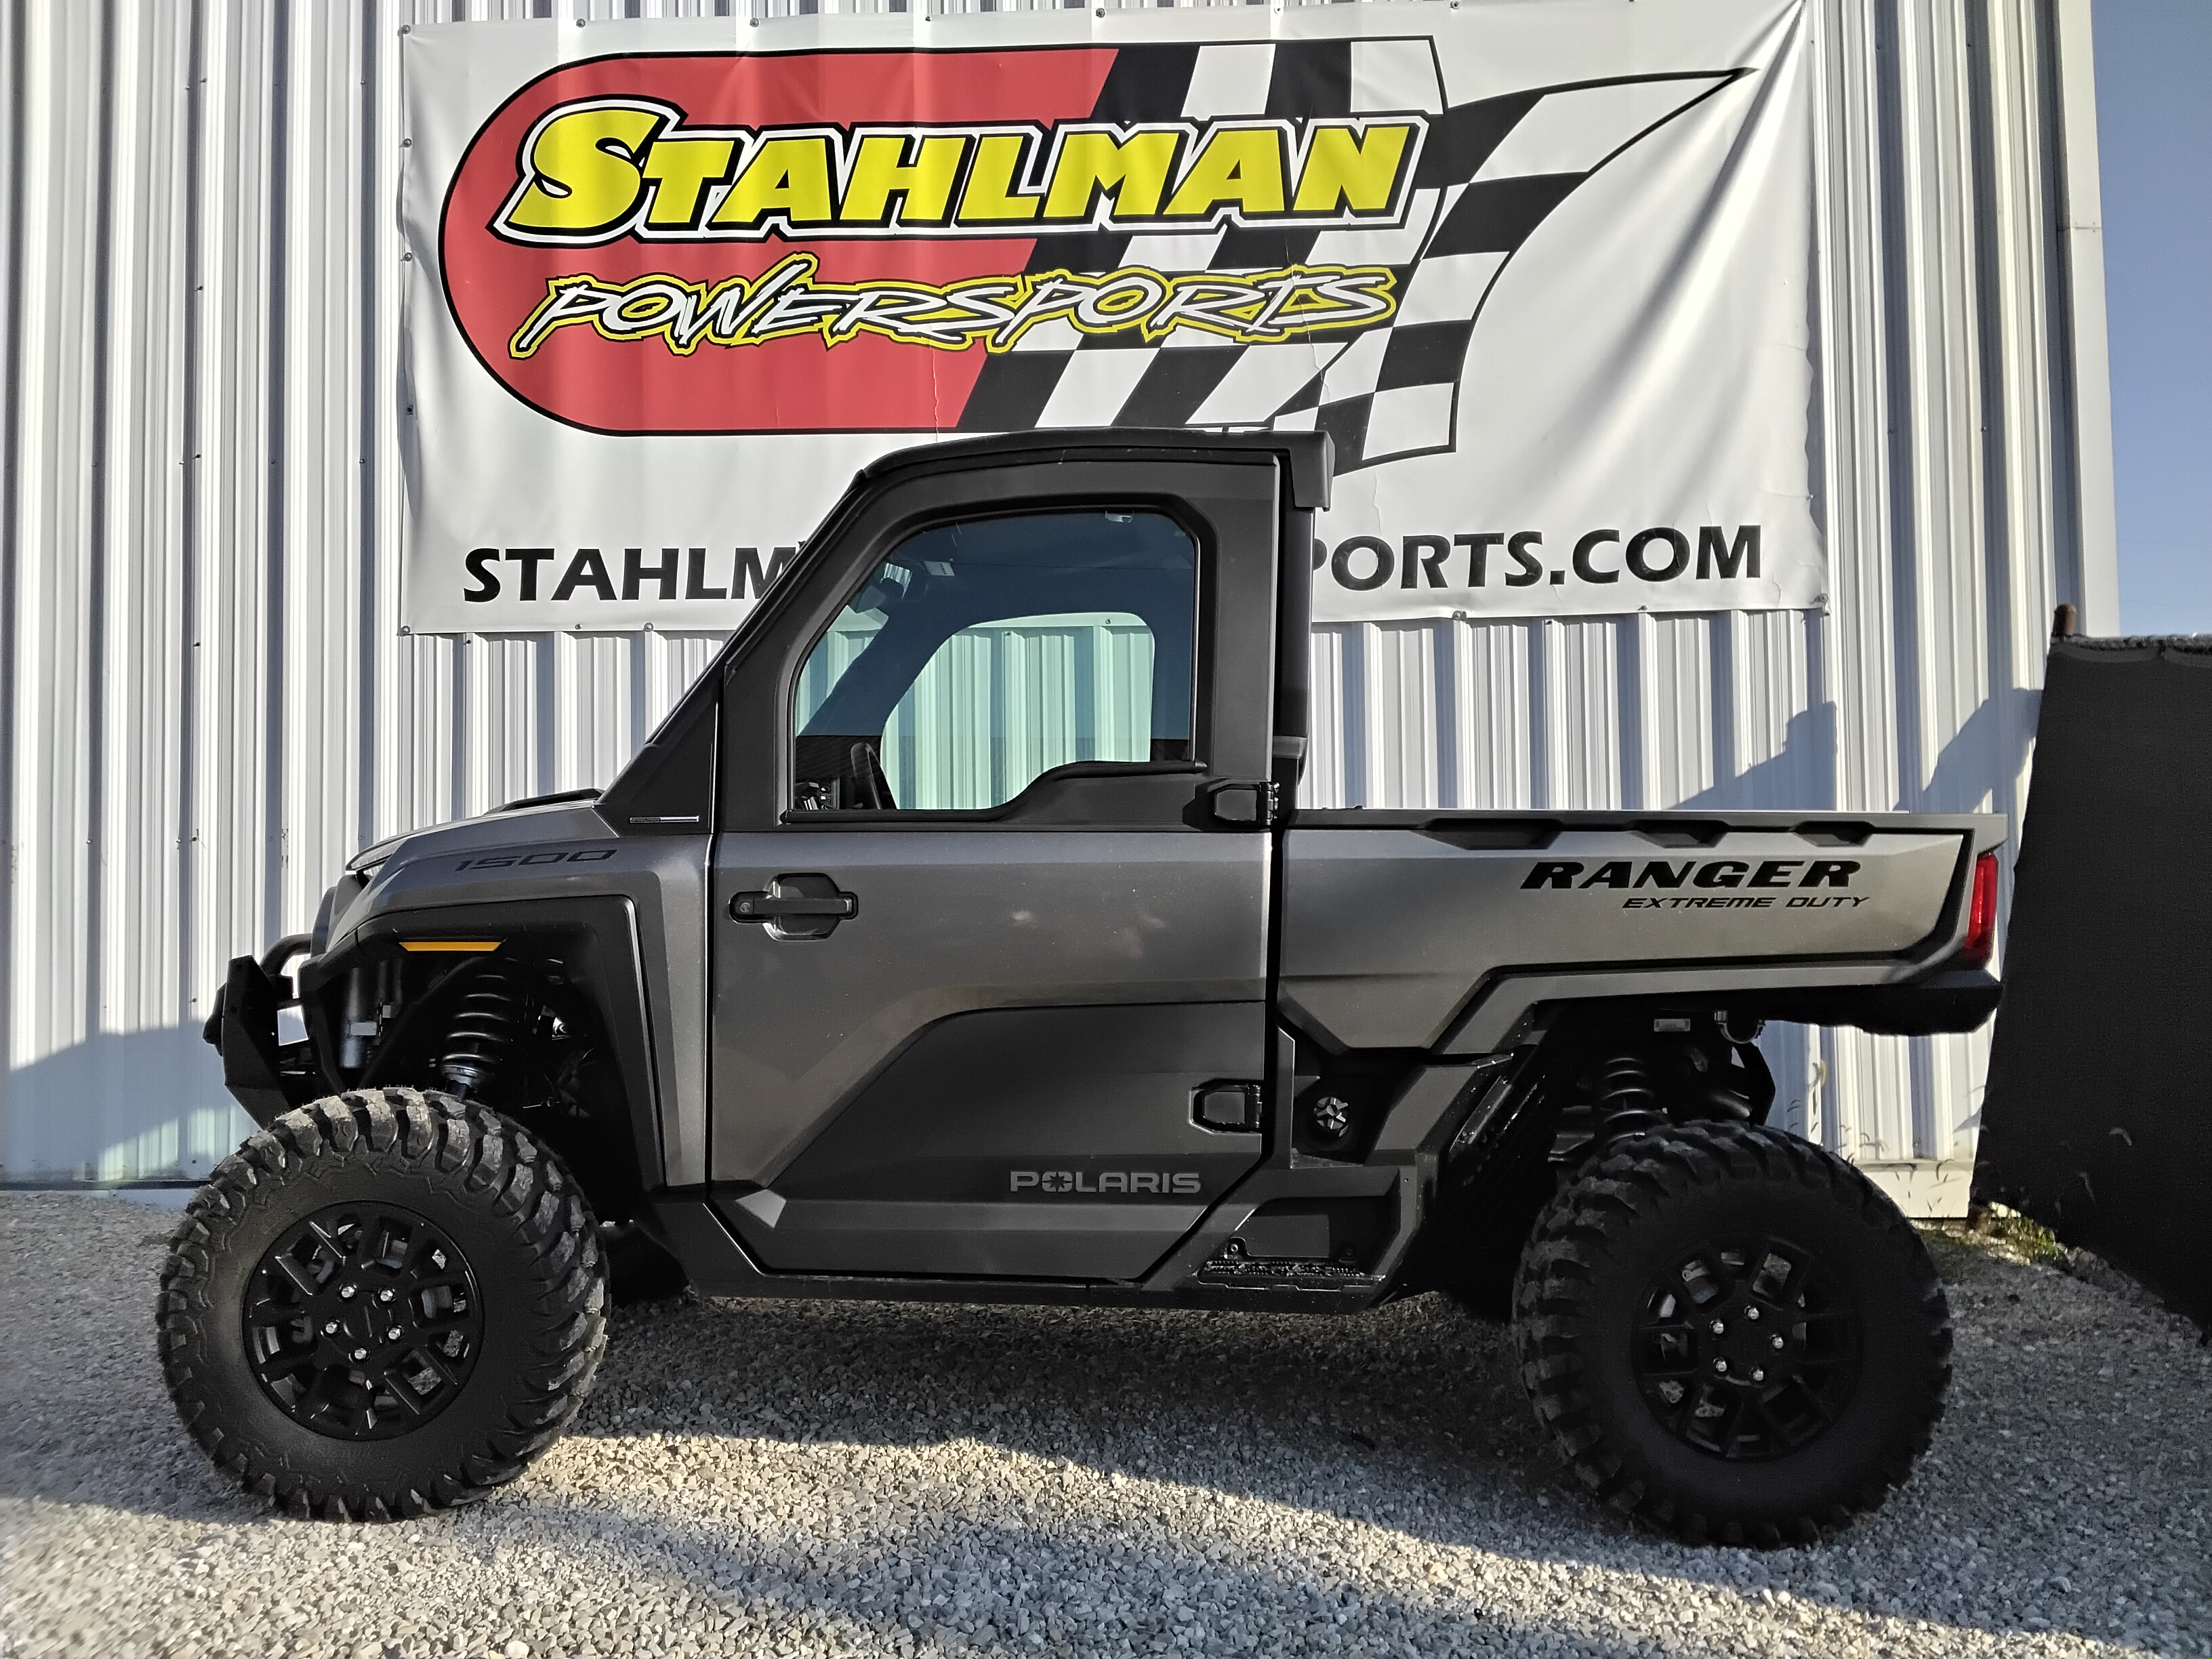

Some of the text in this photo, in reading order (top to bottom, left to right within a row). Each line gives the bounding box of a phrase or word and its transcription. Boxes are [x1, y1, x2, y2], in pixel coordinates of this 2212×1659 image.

[493, 100, 1427, 240] STAHLMAN
[508, 253, 1400, 359] POWERSPORTS
[454, 849, 617, 872] 1500
[1519, 860, 1862, 889] RANGER
[1622, 897, 1871, 909] EXTREME DUTY
[1009, 1170, 1201, 1193] POLARIS
